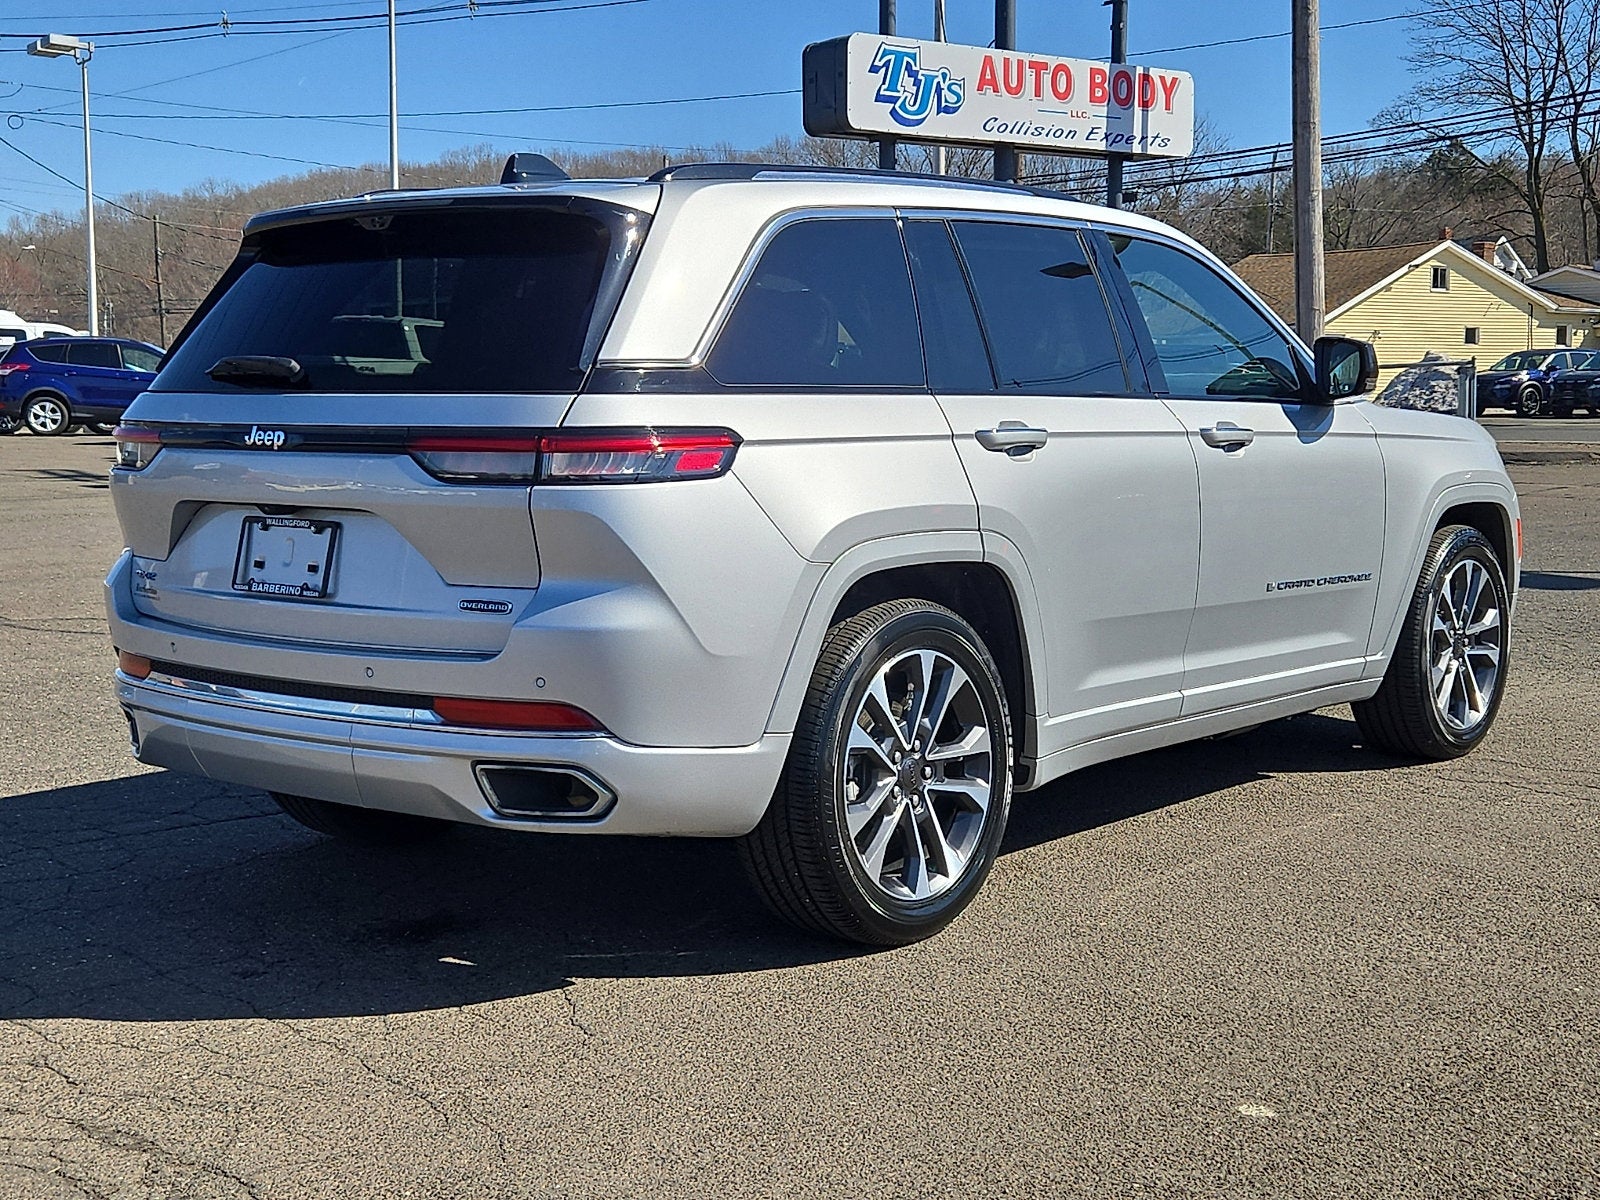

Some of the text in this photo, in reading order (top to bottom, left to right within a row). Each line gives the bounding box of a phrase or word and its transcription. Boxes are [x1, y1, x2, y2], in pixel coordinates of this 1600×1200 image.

[976, 55, 1179, 111] AUTO BODY
[1070, 110, 1090, 120] LLC.
[982, 117, 1171, 148] Collision Experts
[244, 425, 285, 450] Jeep
[266, 518, 310, 528] WALLINGFORD
[251, 582, 301, 595] BARBERINO
[460, 601, 507, 611] OVERLAND
